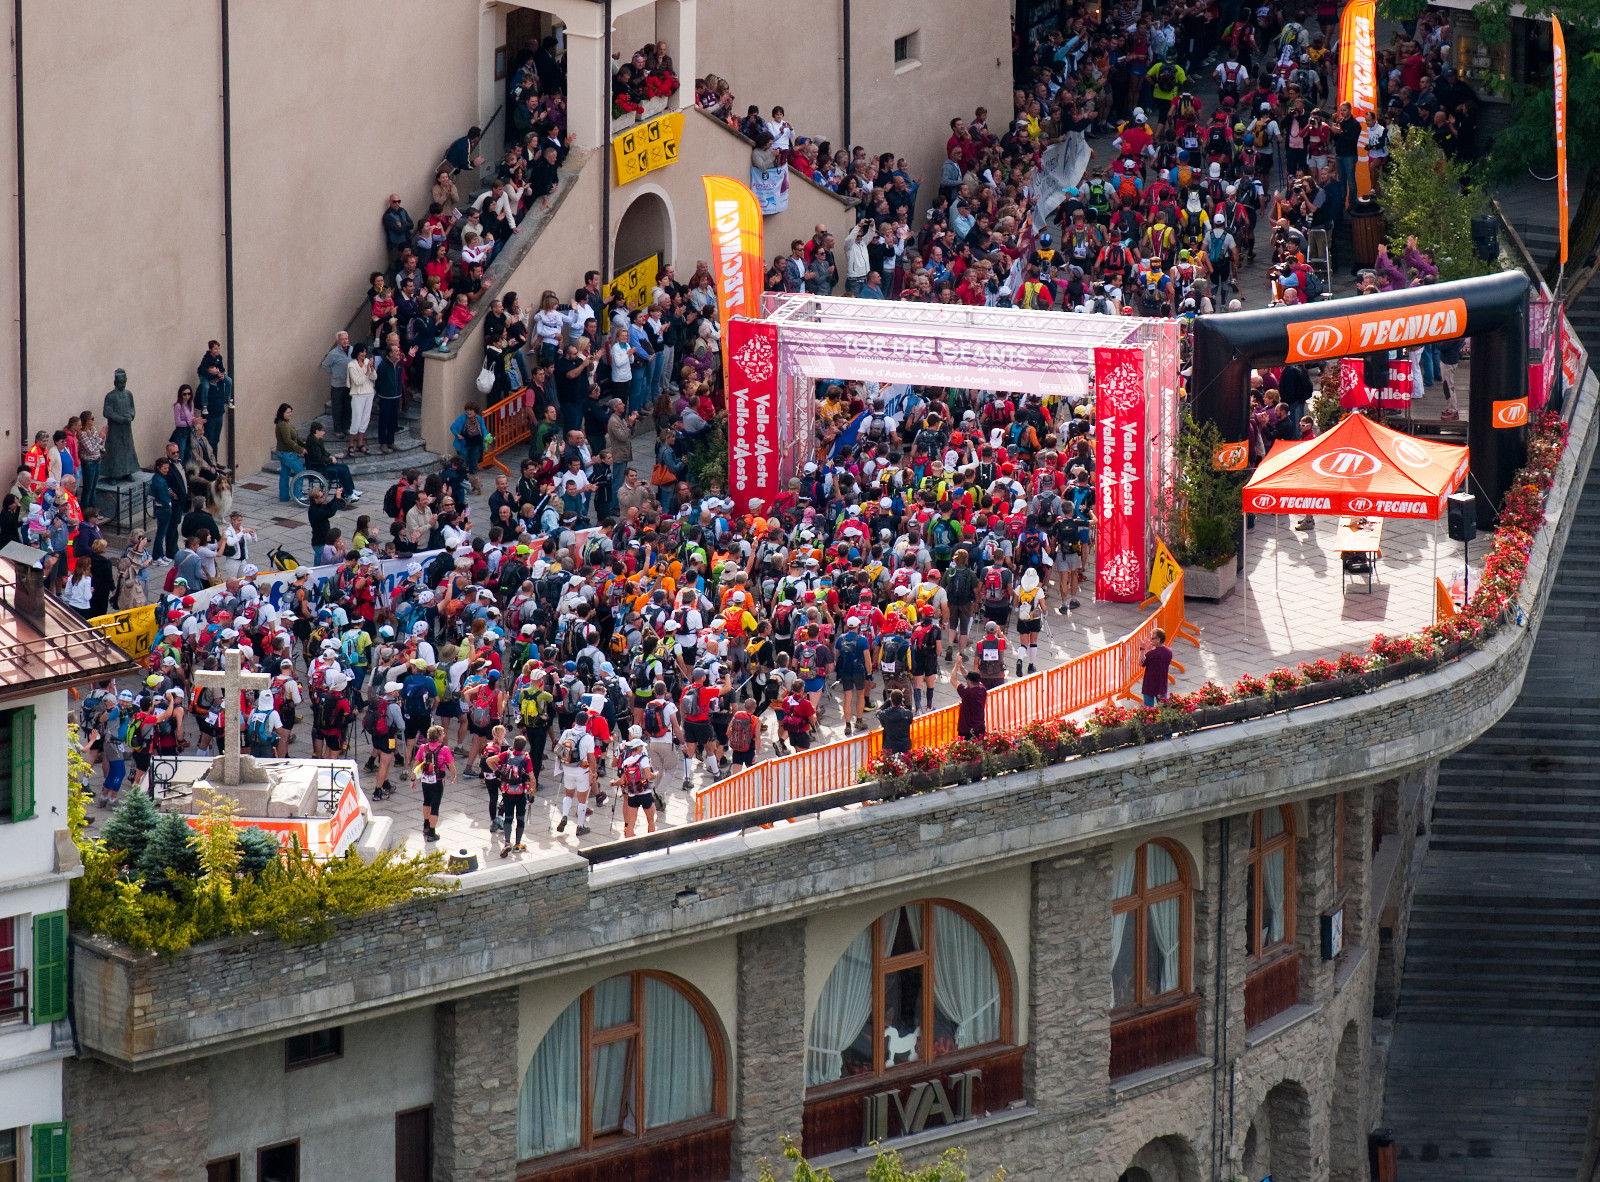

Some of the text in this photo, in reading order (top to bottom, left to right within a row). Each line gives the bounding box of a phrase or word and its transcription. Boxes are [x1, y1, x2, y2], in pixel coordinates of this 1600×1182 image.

[1353, 16, 1374, 111] TECNICA
[1360, 309, 1457, 347] TECNICA
[843, 337, 1028, 363] TOR DES GÉANTS
[849, 367, 874, 376] Valle
[876, 367, 912, 379] d'Aosta
[921, 371, 951, 382] Vallée
[999, 377, 1023, 388] Italia
[1364, 387, 1411, 403] Vallée
[732, 388, 749, 436] Vallée
[753, 394, 770, 433] Valle
[1099, 416, 1115, 465] Vallée
[1120, 422, 1138, 461] Valle
[1279, 496, 1331, 510] TECNICA
[1376, 500, 1428, 514] TECNICA
